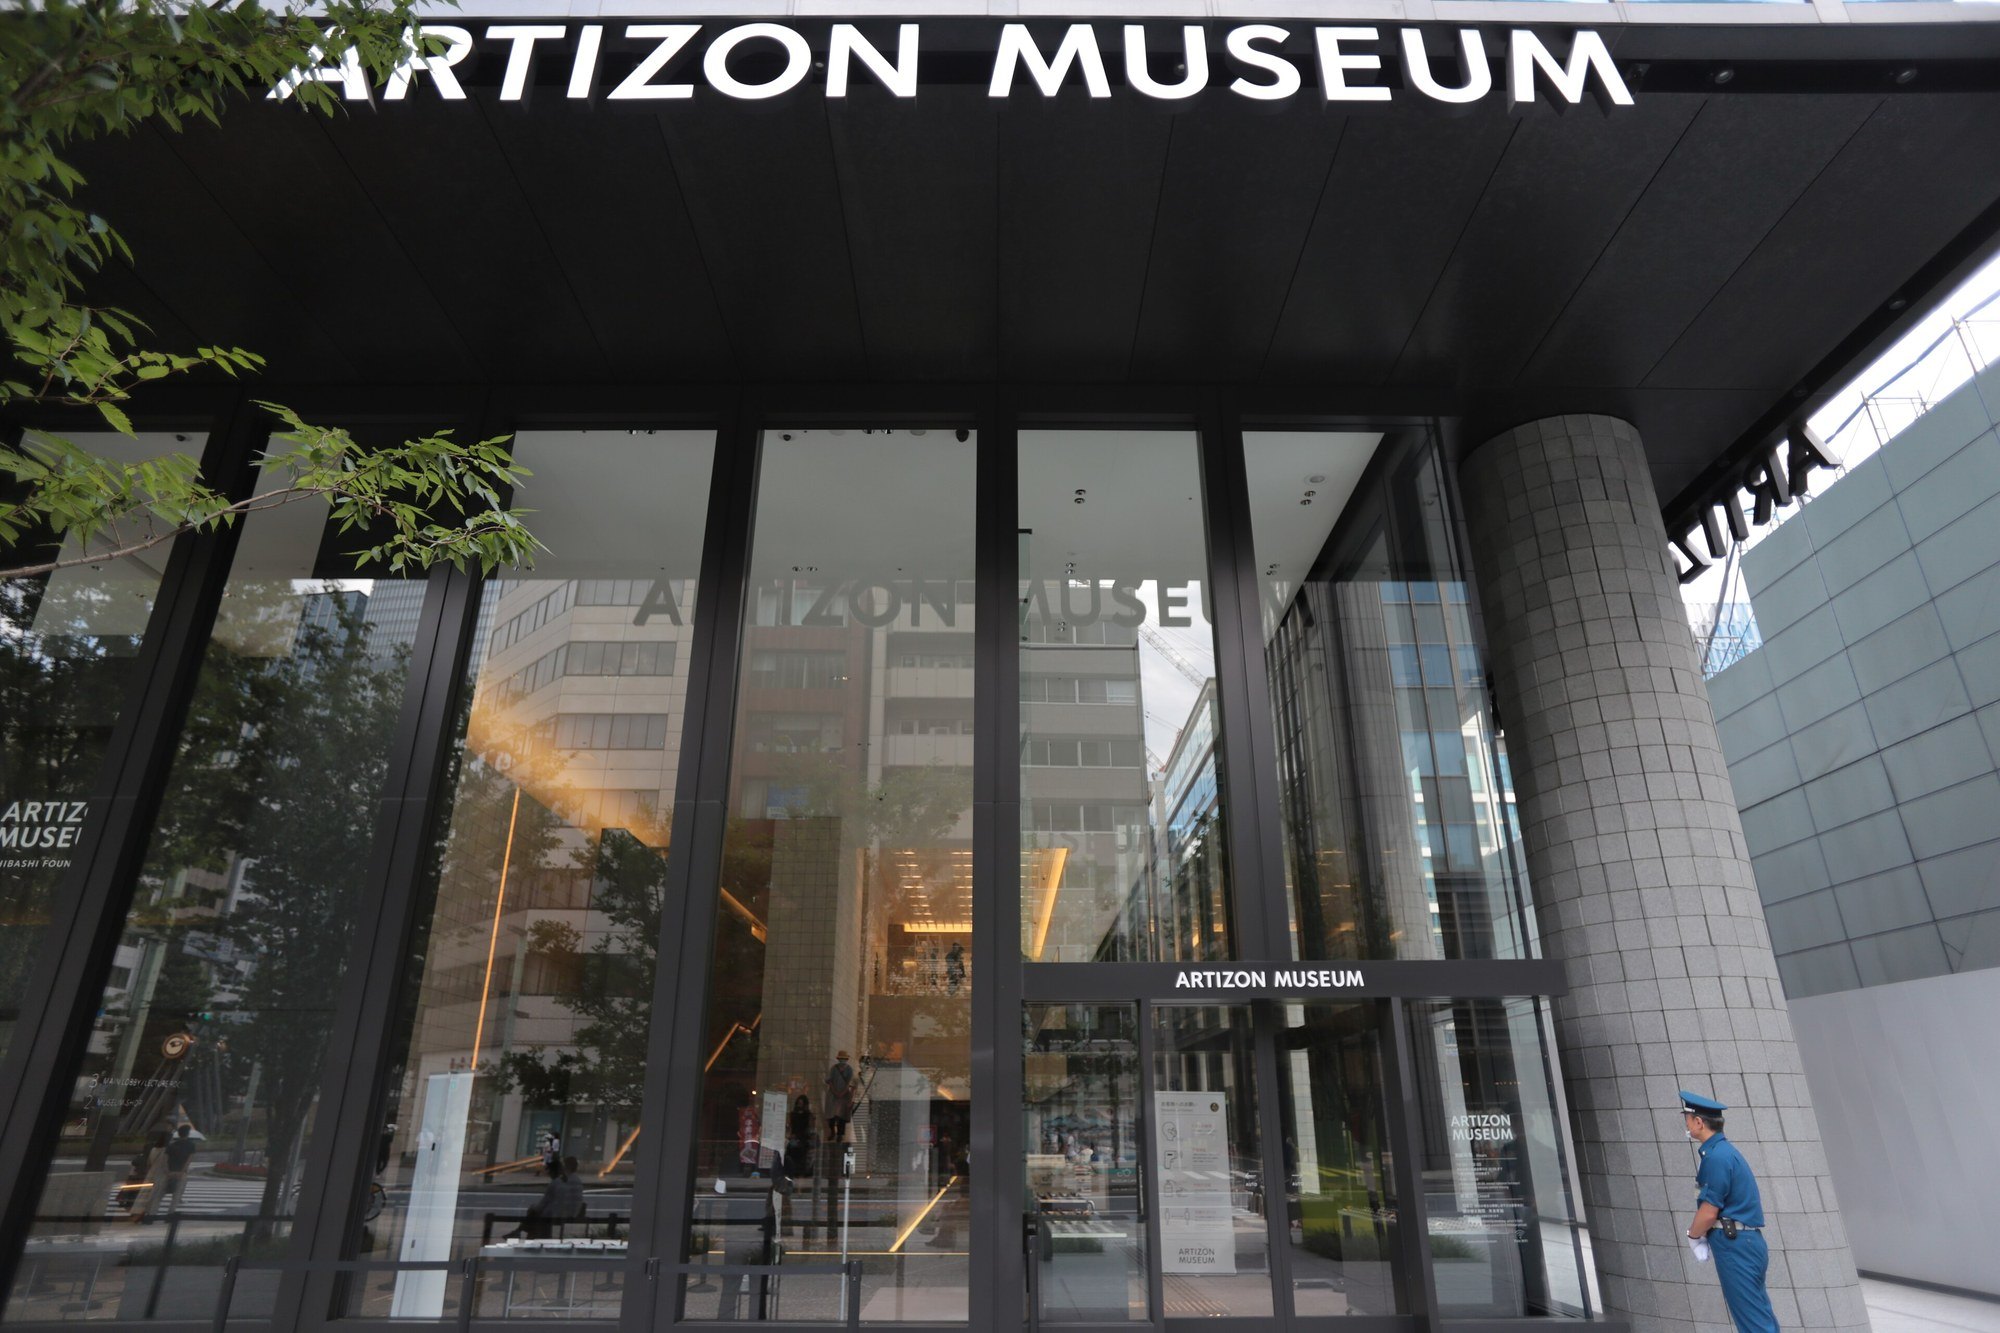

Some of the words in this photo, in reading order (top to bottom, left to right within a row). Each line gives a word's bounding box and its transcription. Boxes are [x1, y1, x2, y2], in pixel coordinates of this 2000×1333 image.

[265, 23, 919, 101] ARTIZON
[988, 23, 1635, 104] MUSEUM
[0, 801, 89, 822] ARTIZ
[0, 826, 83, 848] MUSE
[1175, 971, 1266, 988] ARTIZON
[1274, 970, 1365, 988] MUSEUM
[1450, 1114, 1511, 1127] ARTIZON
[1452, 1128, 1513, 1141] MUSEUM
[1178, 1248, 1215, 1256] ARTIZON
[1178, 1256, 1215, 1264] MUSEUM
